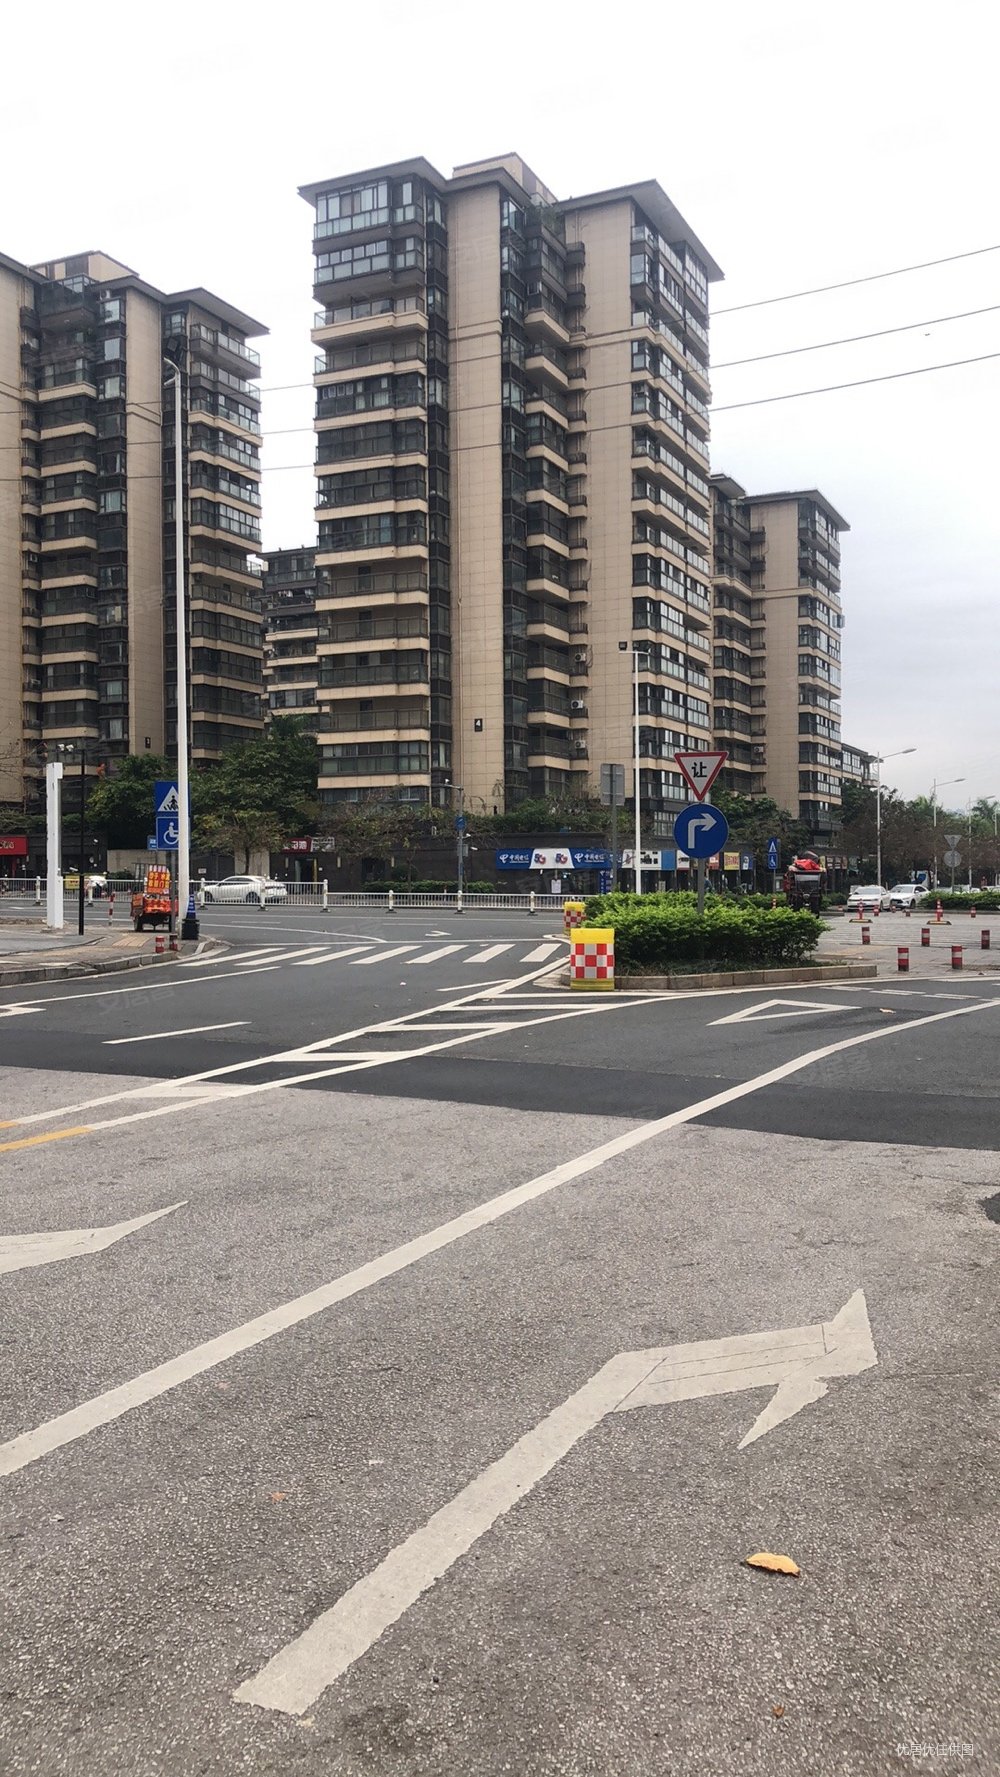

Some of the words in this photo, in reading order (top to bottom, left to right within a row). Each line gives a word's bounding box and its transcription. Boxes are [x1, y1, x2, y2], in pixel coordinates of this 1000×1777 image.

[691, 761, 708, 778] 让
[534, 853, 546, 865] 5G
[555, 853, 568, 865] 5G
